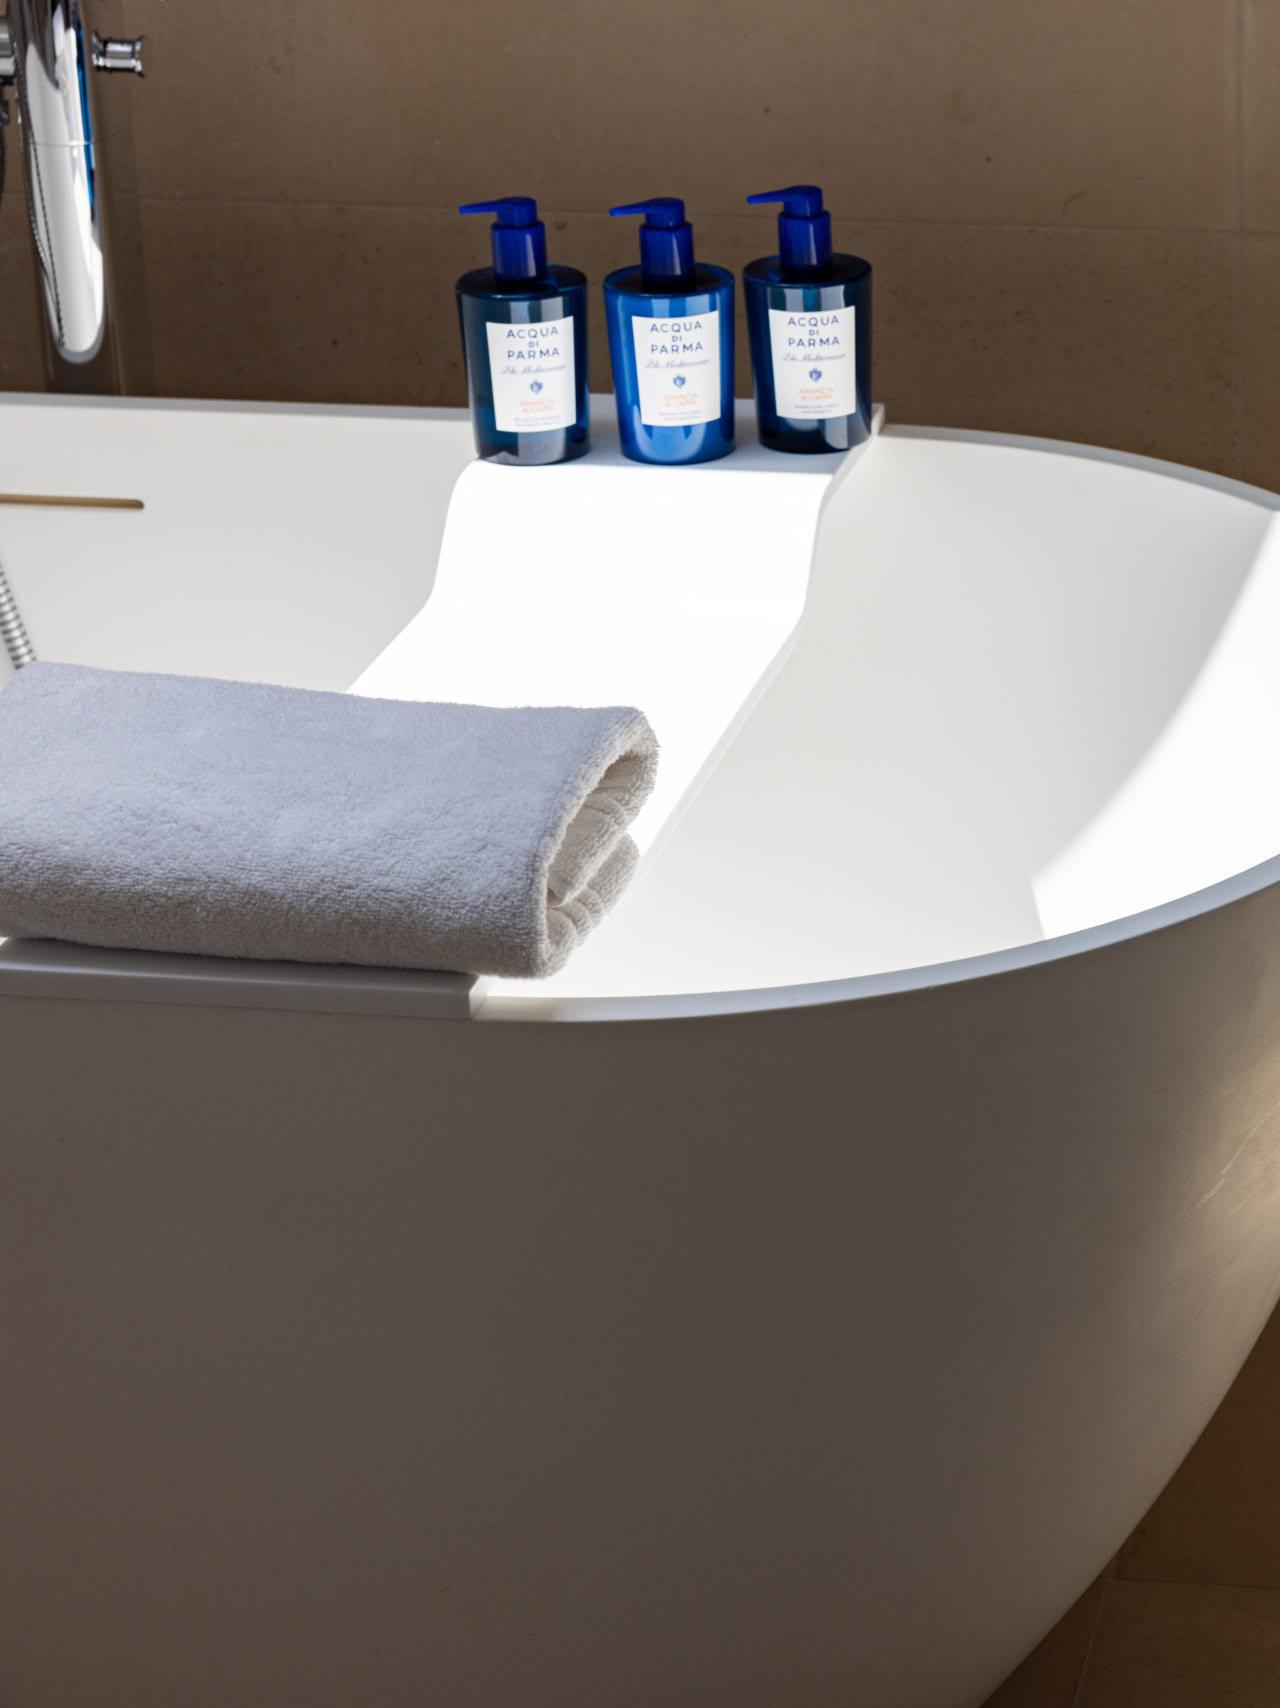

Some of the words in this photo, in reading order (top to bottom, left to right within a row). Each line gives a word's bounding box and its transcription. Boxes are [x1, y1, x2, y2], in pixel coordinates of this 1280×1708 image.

[650, 320, 702, 333] ACQUA
[787, 315, 840, 327] ACQUA
[506, 326, 559, 339] ACQUA
[651, 342, 703, 354] PARMA
[788, 336, 840, 348] PARMA
[507, 347, 560, 360] PARMA
